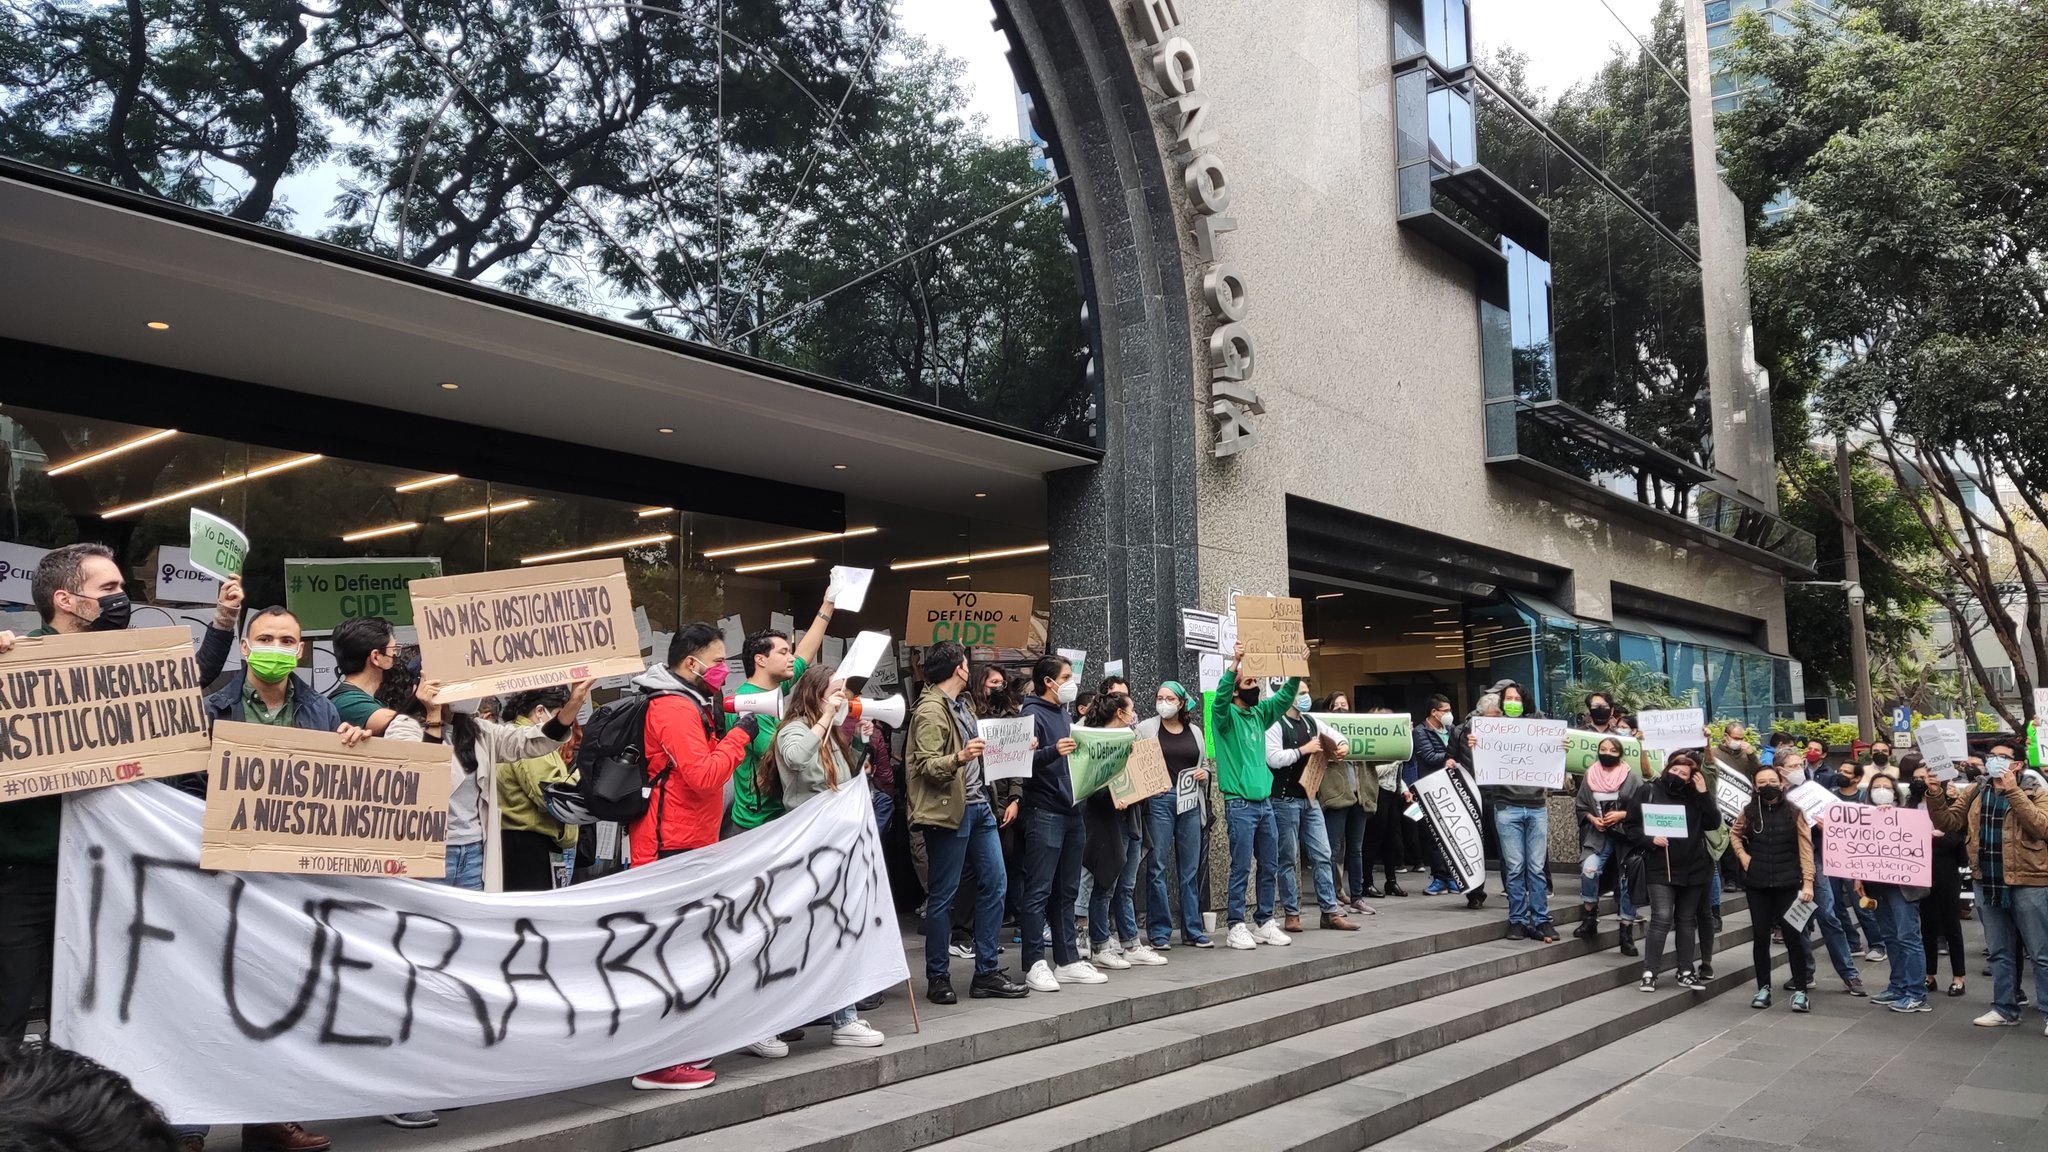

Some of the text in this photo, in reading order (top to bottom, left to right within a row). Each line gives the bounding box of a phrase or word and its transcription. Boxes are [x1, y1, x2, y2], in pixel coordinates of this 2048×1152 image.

[204, 524, 215, 540] Yo
[11, 568, 33, 580] CID
[175, 569, 205, 581] CIDE
[307, 574, 328, 592] Yo
[340, 593, 398, 618] CIDE
[953, 592, 977, 607] YO
[456, 596, 491, 634] MÁS
[492, 585, 612, 632] HOSTIGAMIENTO
[927, 610, 1019, 622] DEFIENDO AL
[493, 617, 617, 664] CONOCIMIENTO!
[932, 621, 997, 646] CIDE
[569, 666, 592, 680] CIDE
[68, 666, 92, 704] NI
[135, 695, 208, 741] PLURAL!
[1893, 709, 1904, 727] P
[1392, 723, 1407, 737] Al
[1474, 718, 1567, 737] ROMERO OPRESOR
[1347, 738, 1377, 755] DE
[1474, 738, 1563, 755] NO QUIERO QUE
[1500, 754, 1535, 766] SEAS
[40, 769, 98, 792] DEFIENDO
[99, 766, 116, 783] AL
[115, 761, 145, 781] CIDE
[267, 753, 310, 798] MÁS
[312, 762, 420, 806] DIFAMACIÓN
[1476, 767, 1564, 784] MI DIRECTOR
[1452, 776, 1479, 819] ACADÉMICO
[231, 797, 248, 830] A
[254, 798, 337, 836] NUESTRA
[1830, 805, 1871, 826] CIDE
[1884, 810, 1898, 827] al
[1431, 786, 1485, 872] SIPACIDE
[1826, 825, 1913, 843] servicio de
[1826, 839, 1925, 859] la sociedad
[327, 856, 371, 874] DEFIENDO
[1825, 858, 1921, 874] No del gobierno
[1851, 870, 1911, 883] en turno
